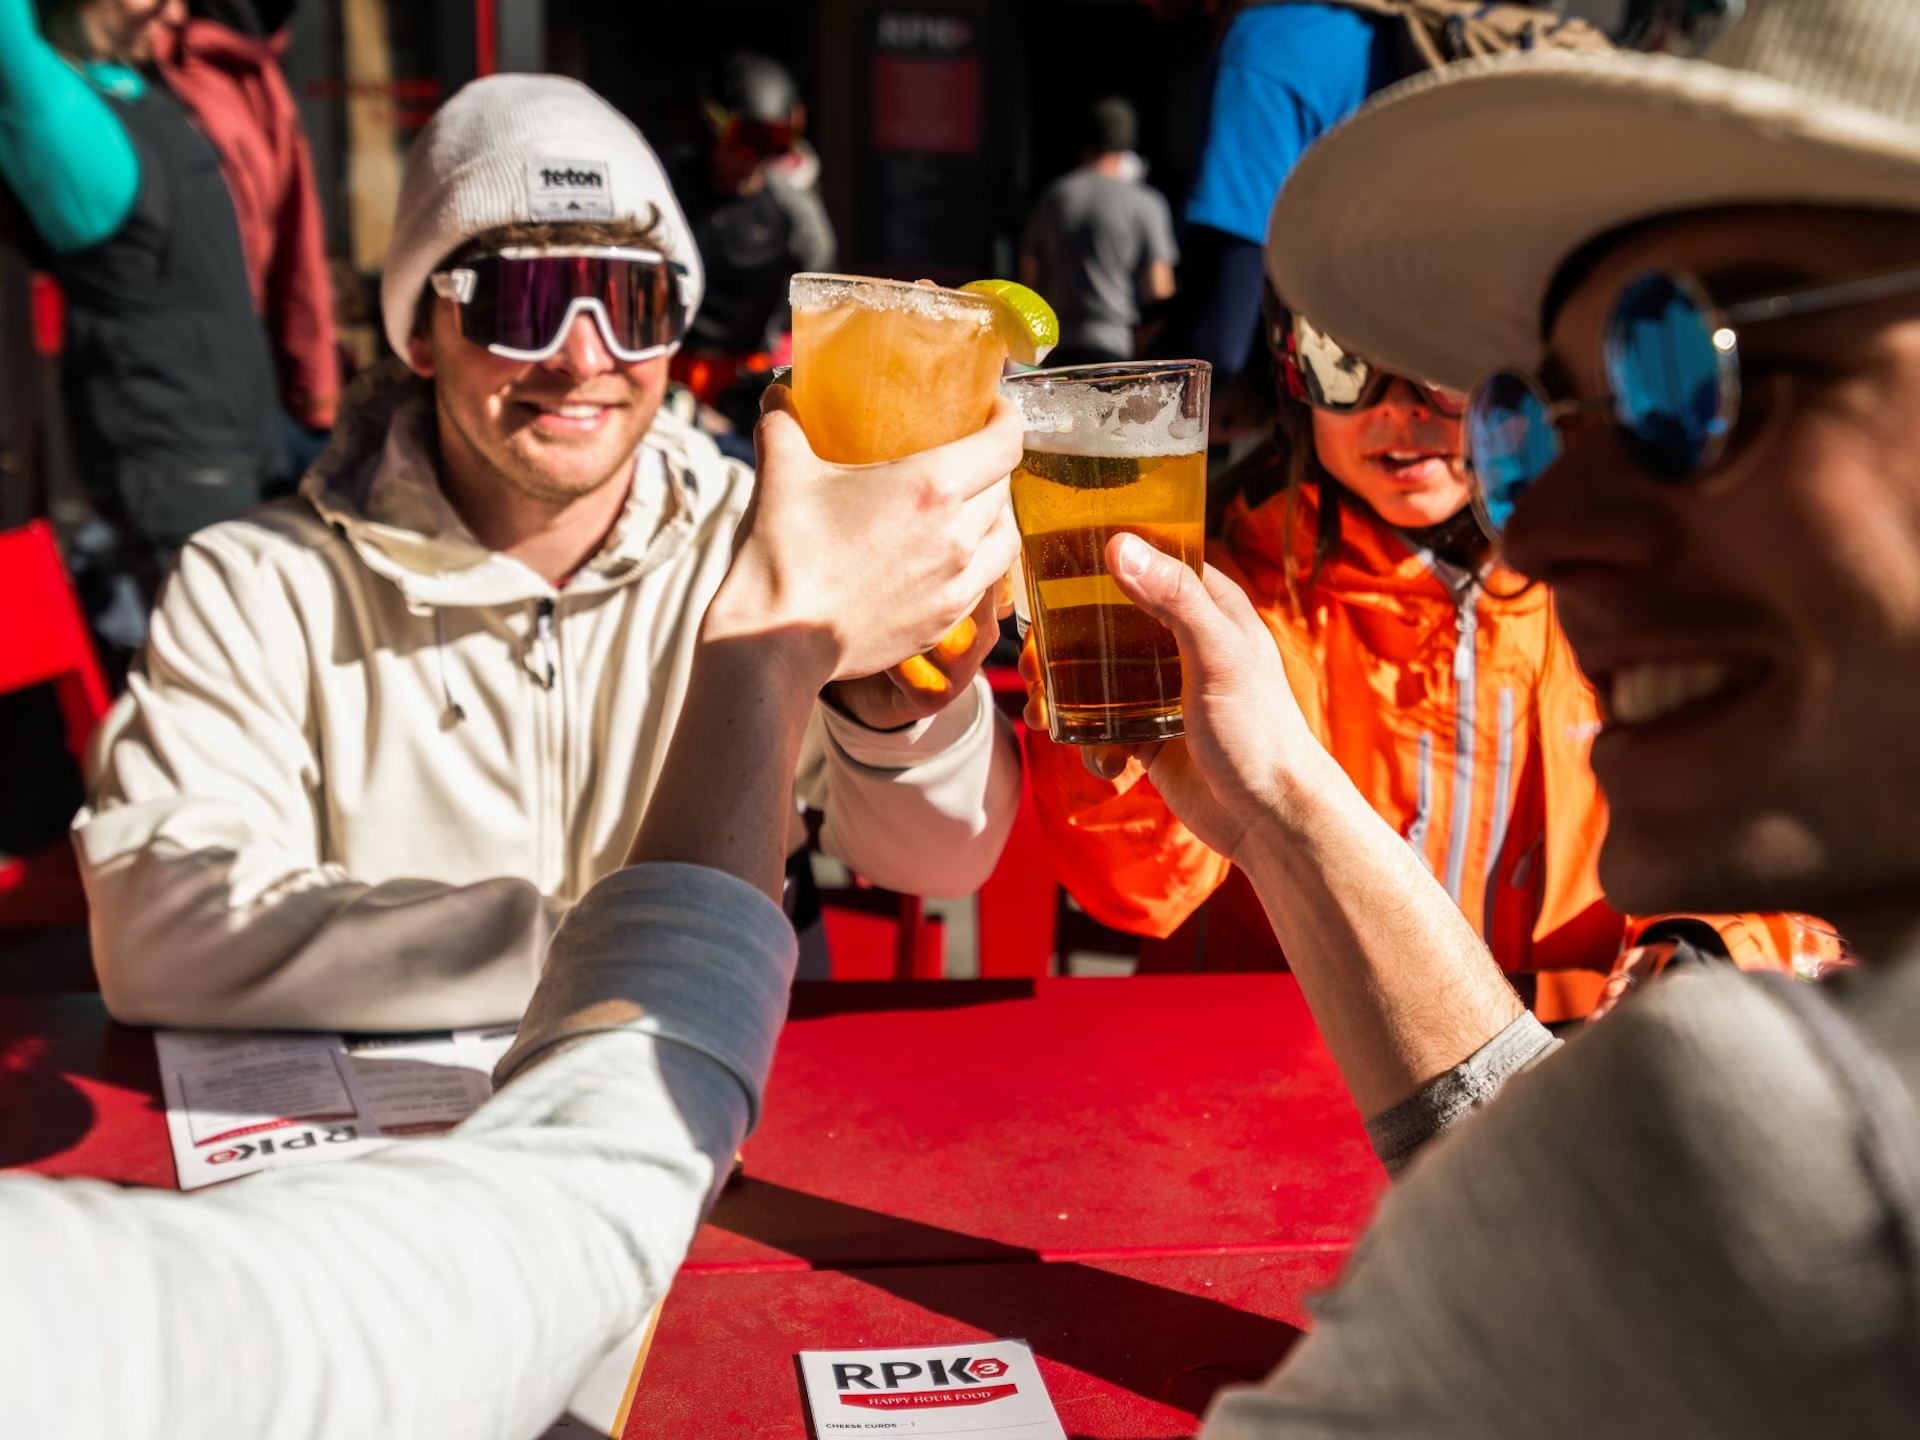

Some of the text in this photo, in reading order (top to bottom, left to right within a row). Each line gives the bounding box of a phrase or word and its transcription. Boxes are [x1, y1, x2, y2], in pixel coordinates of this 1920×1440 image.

[540, 167, 603, 188] teton
[868, 1390, 992, 1406] HAPPY HOUR FOOD
